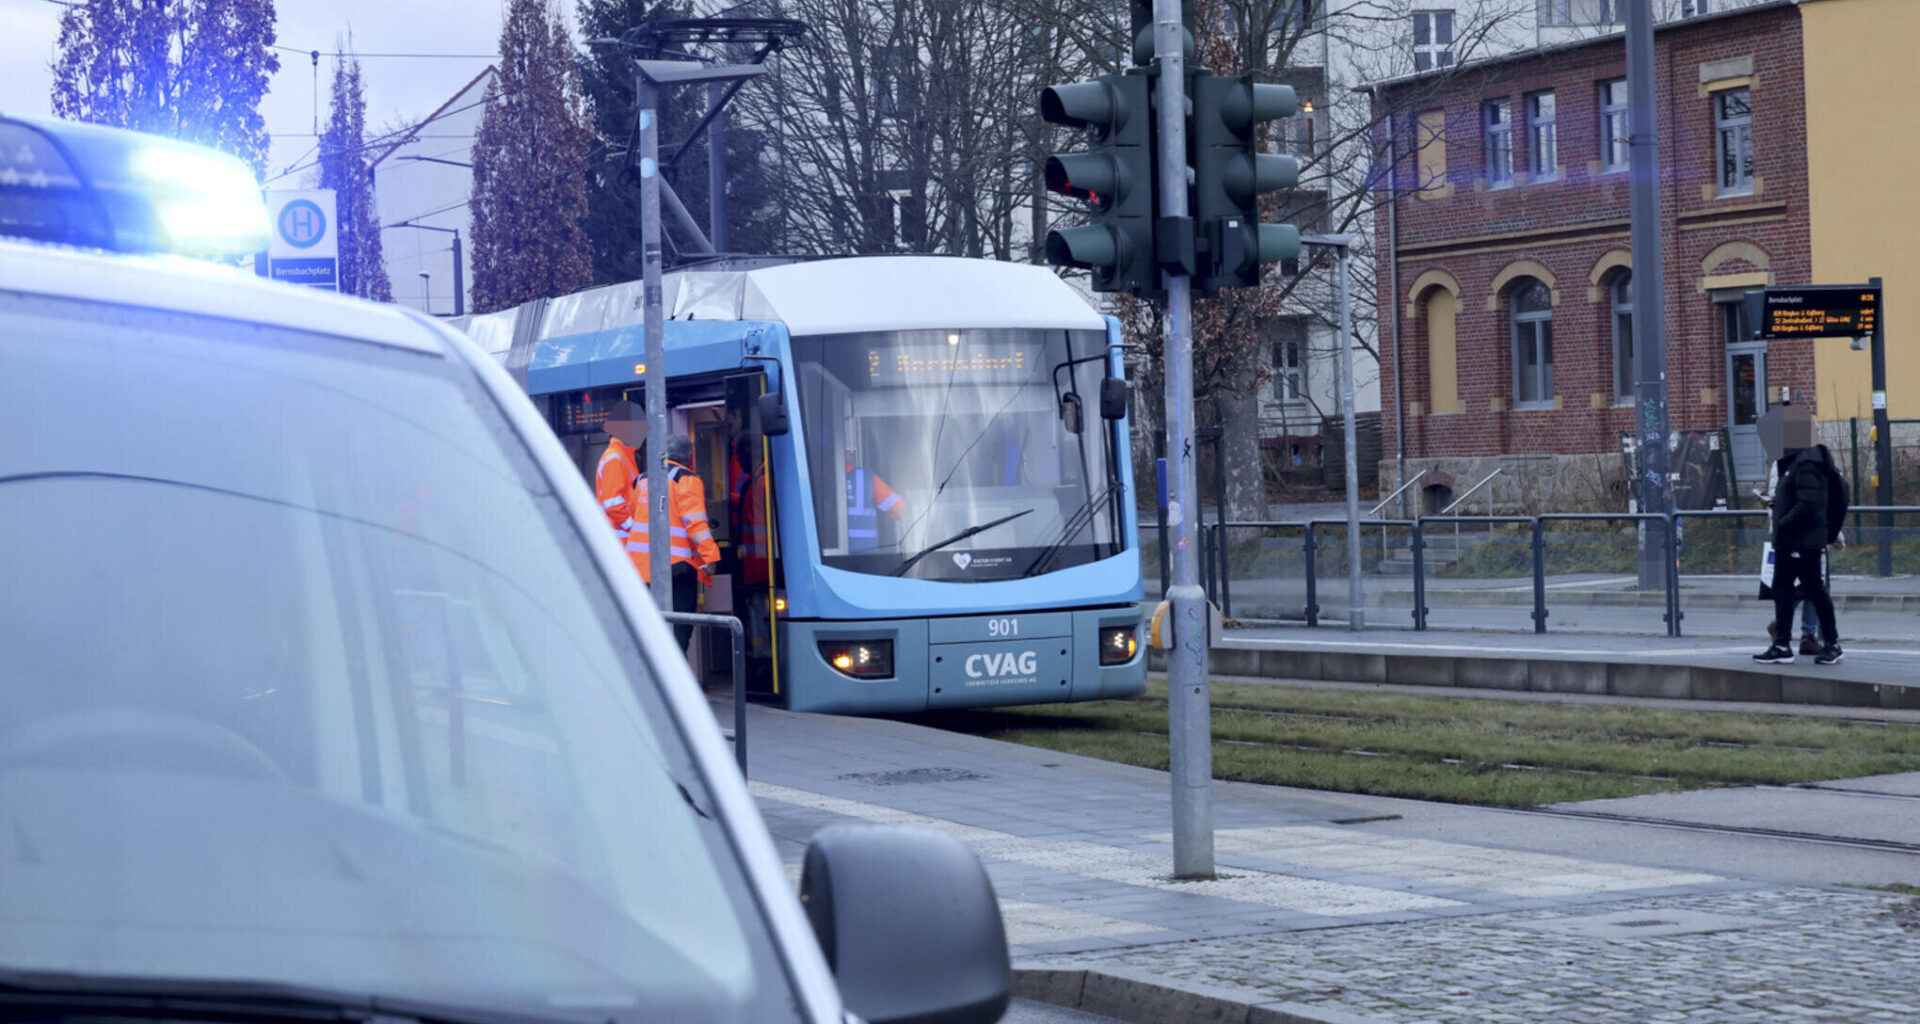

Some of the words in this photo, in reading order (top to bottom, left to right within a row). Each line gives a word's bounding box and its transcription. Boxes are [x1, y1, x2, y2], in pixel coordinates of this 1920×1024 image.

[293, 211, 311, 237] H
[276, 265, 330, 276] Bernsbachplatz
[988, 618, 1018, 637] 901
[965, 651, 1037, 679] CVAG
